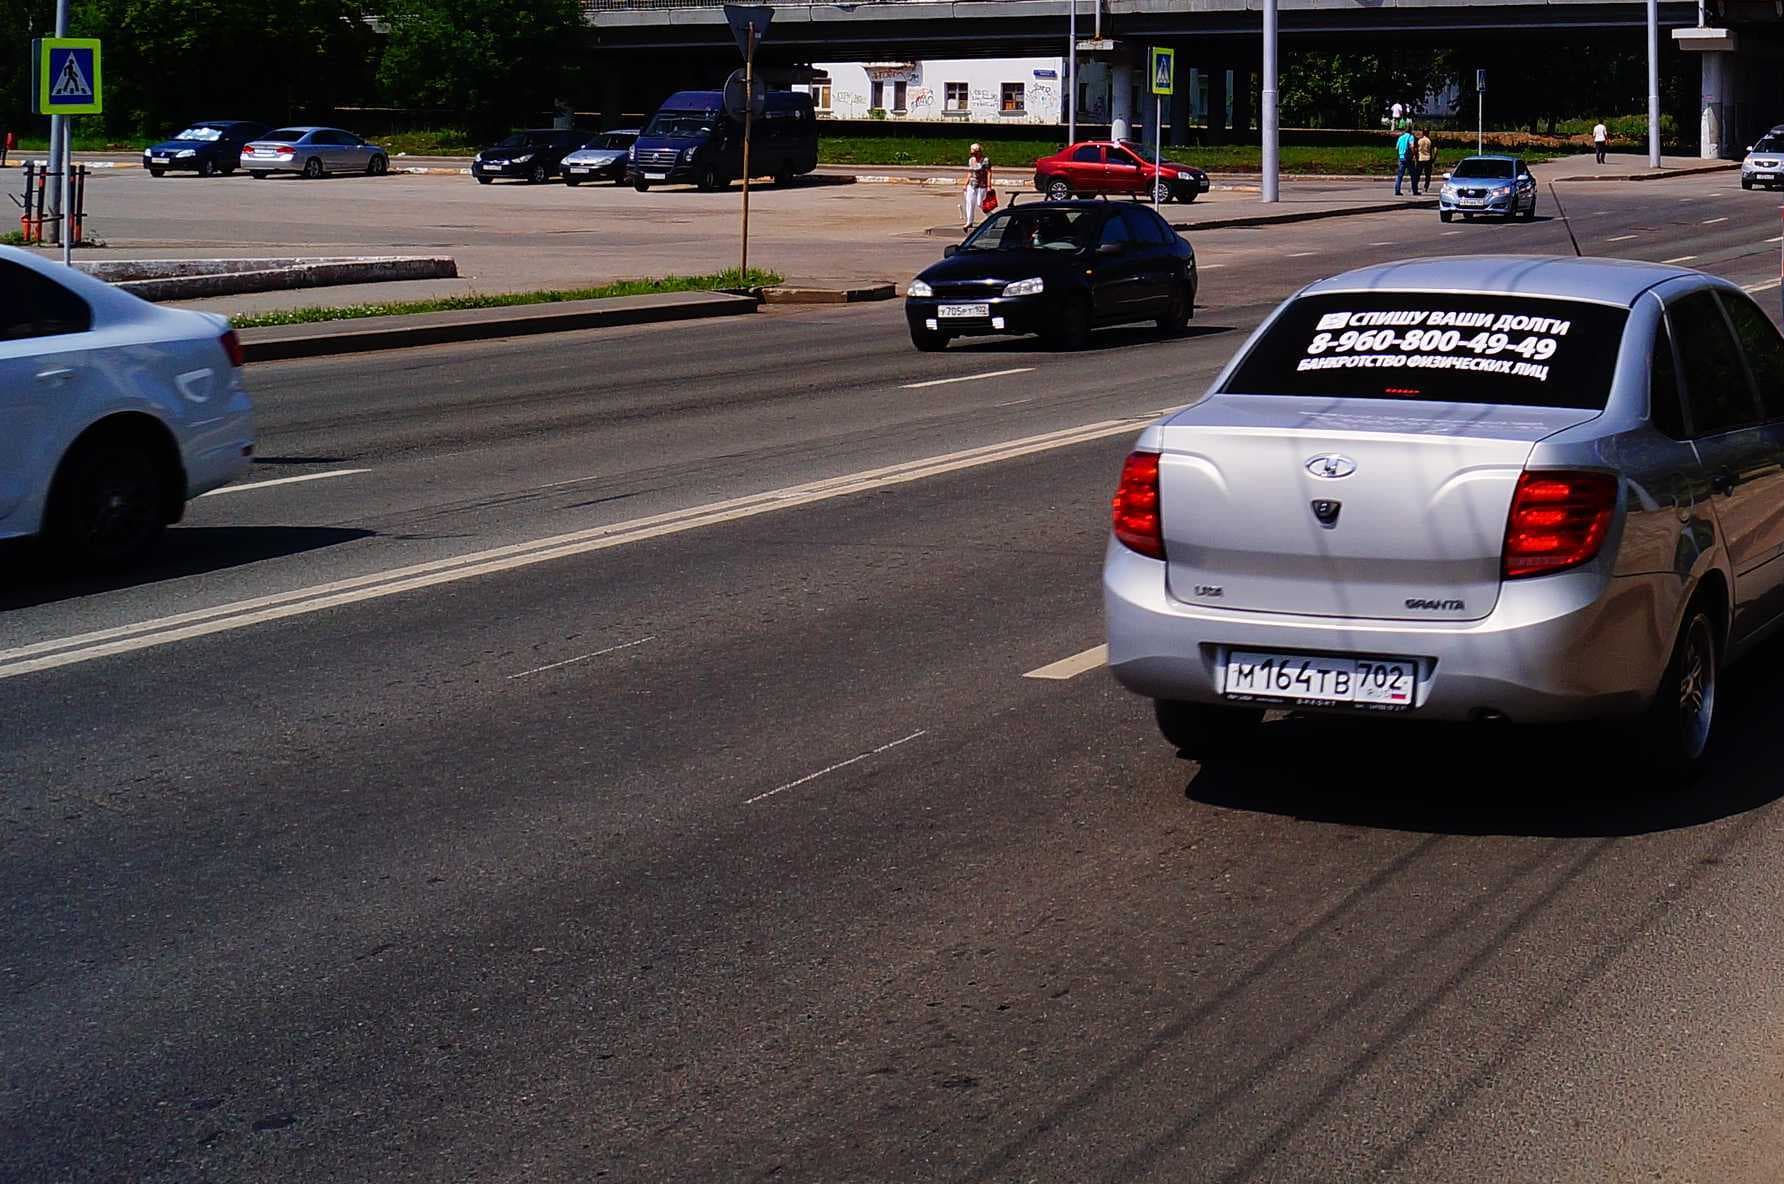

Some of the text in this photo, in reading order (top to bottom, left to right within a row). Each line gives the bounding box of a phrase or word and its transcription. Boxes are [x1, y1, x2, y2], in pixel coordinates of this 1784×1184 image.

[1349, 311, 1571, 335] СПИШУ ВАШИ ДОЛГИ
[1307, 329, 1557, 360] 8-960-800-49-49
[1297, 355, 1550, 381] БАНКРОТСТВО ФИЗИЧЕСКИХ ЛИЦ
[1405, 598, 1465, 611] GRANTA
[1359, 663, 1403, 690] 702
